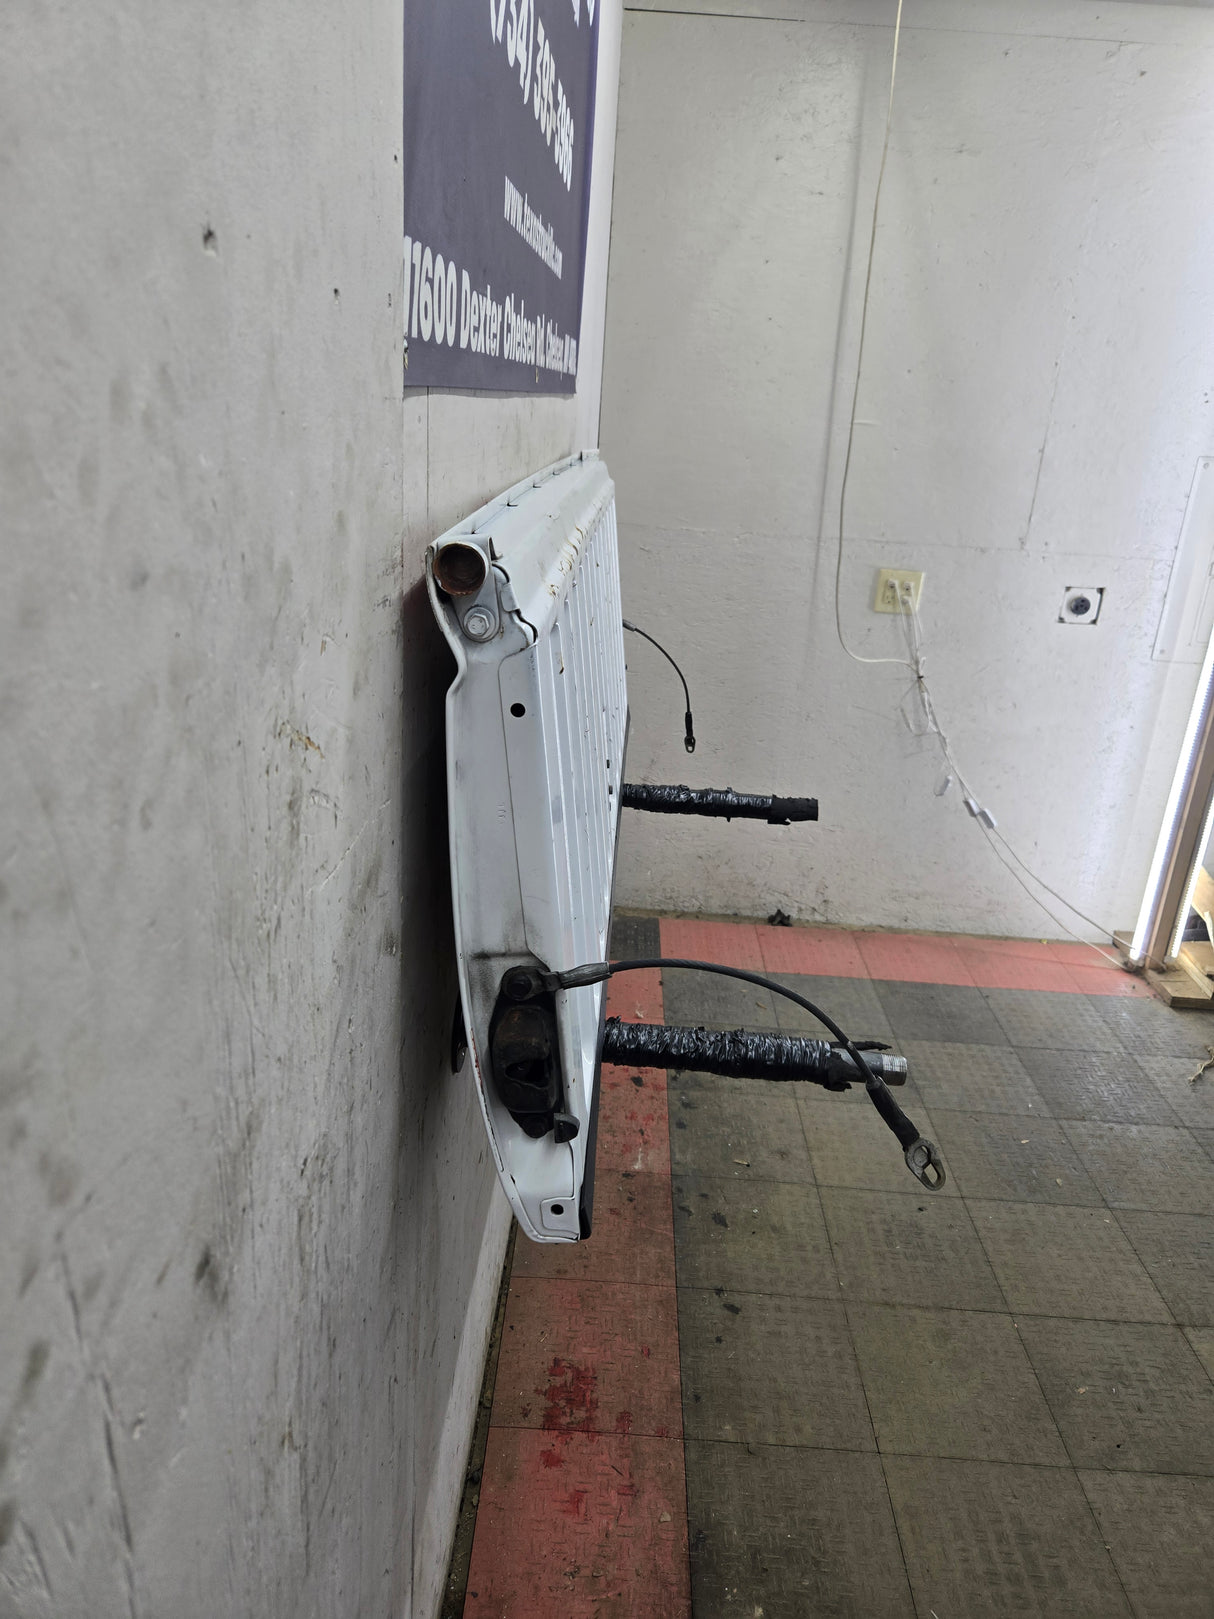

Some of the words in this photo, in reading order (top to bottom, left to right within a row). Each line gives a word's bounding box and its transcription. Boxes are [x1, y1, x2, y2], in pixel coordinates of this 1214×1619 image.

[533, 16, 574, 192] 395-3966
[403, 235, 457, 347] 11600
[460, 269, 502, 357] Dexter
[504, 293, 536, 366] Chelsea
